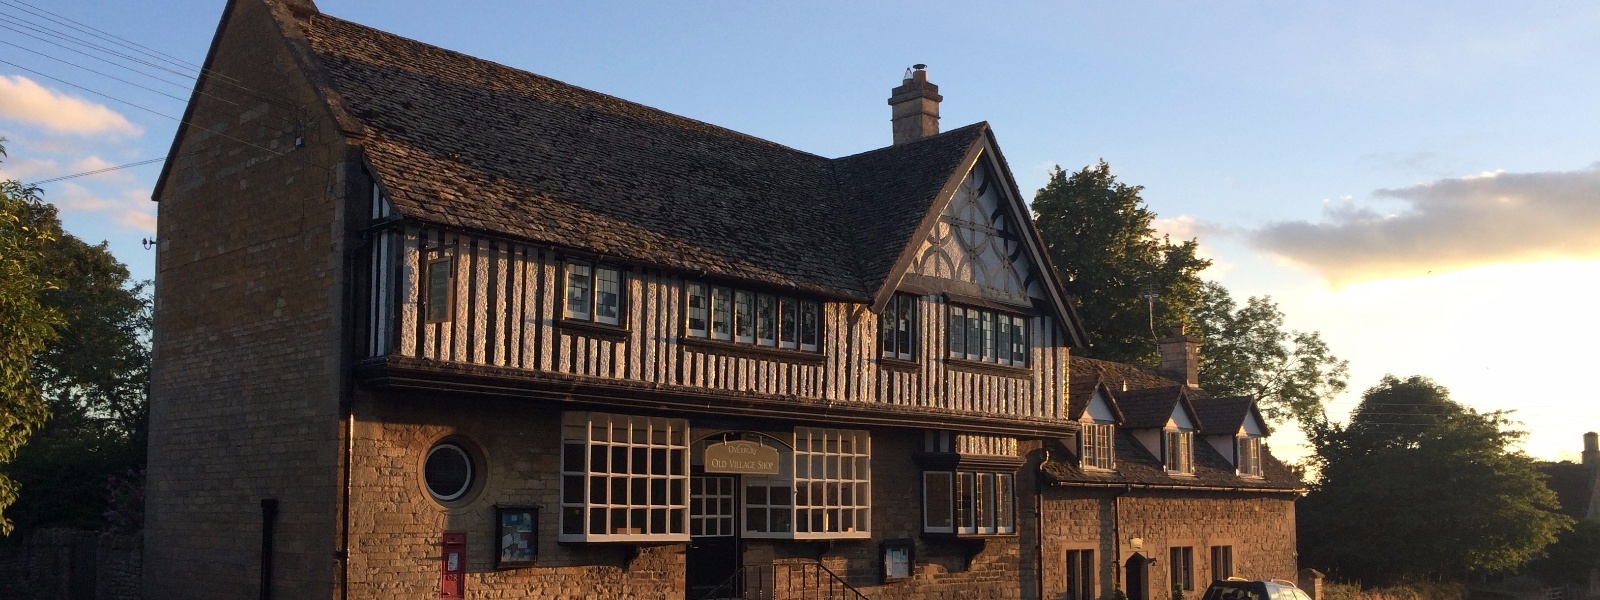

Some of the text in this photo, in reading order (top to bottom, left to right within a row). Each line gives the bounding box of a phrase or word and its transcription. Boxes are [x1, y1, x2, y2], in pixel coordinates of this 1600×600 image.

[711, 458, 774, 470] OLD VILLAGE SHOP
